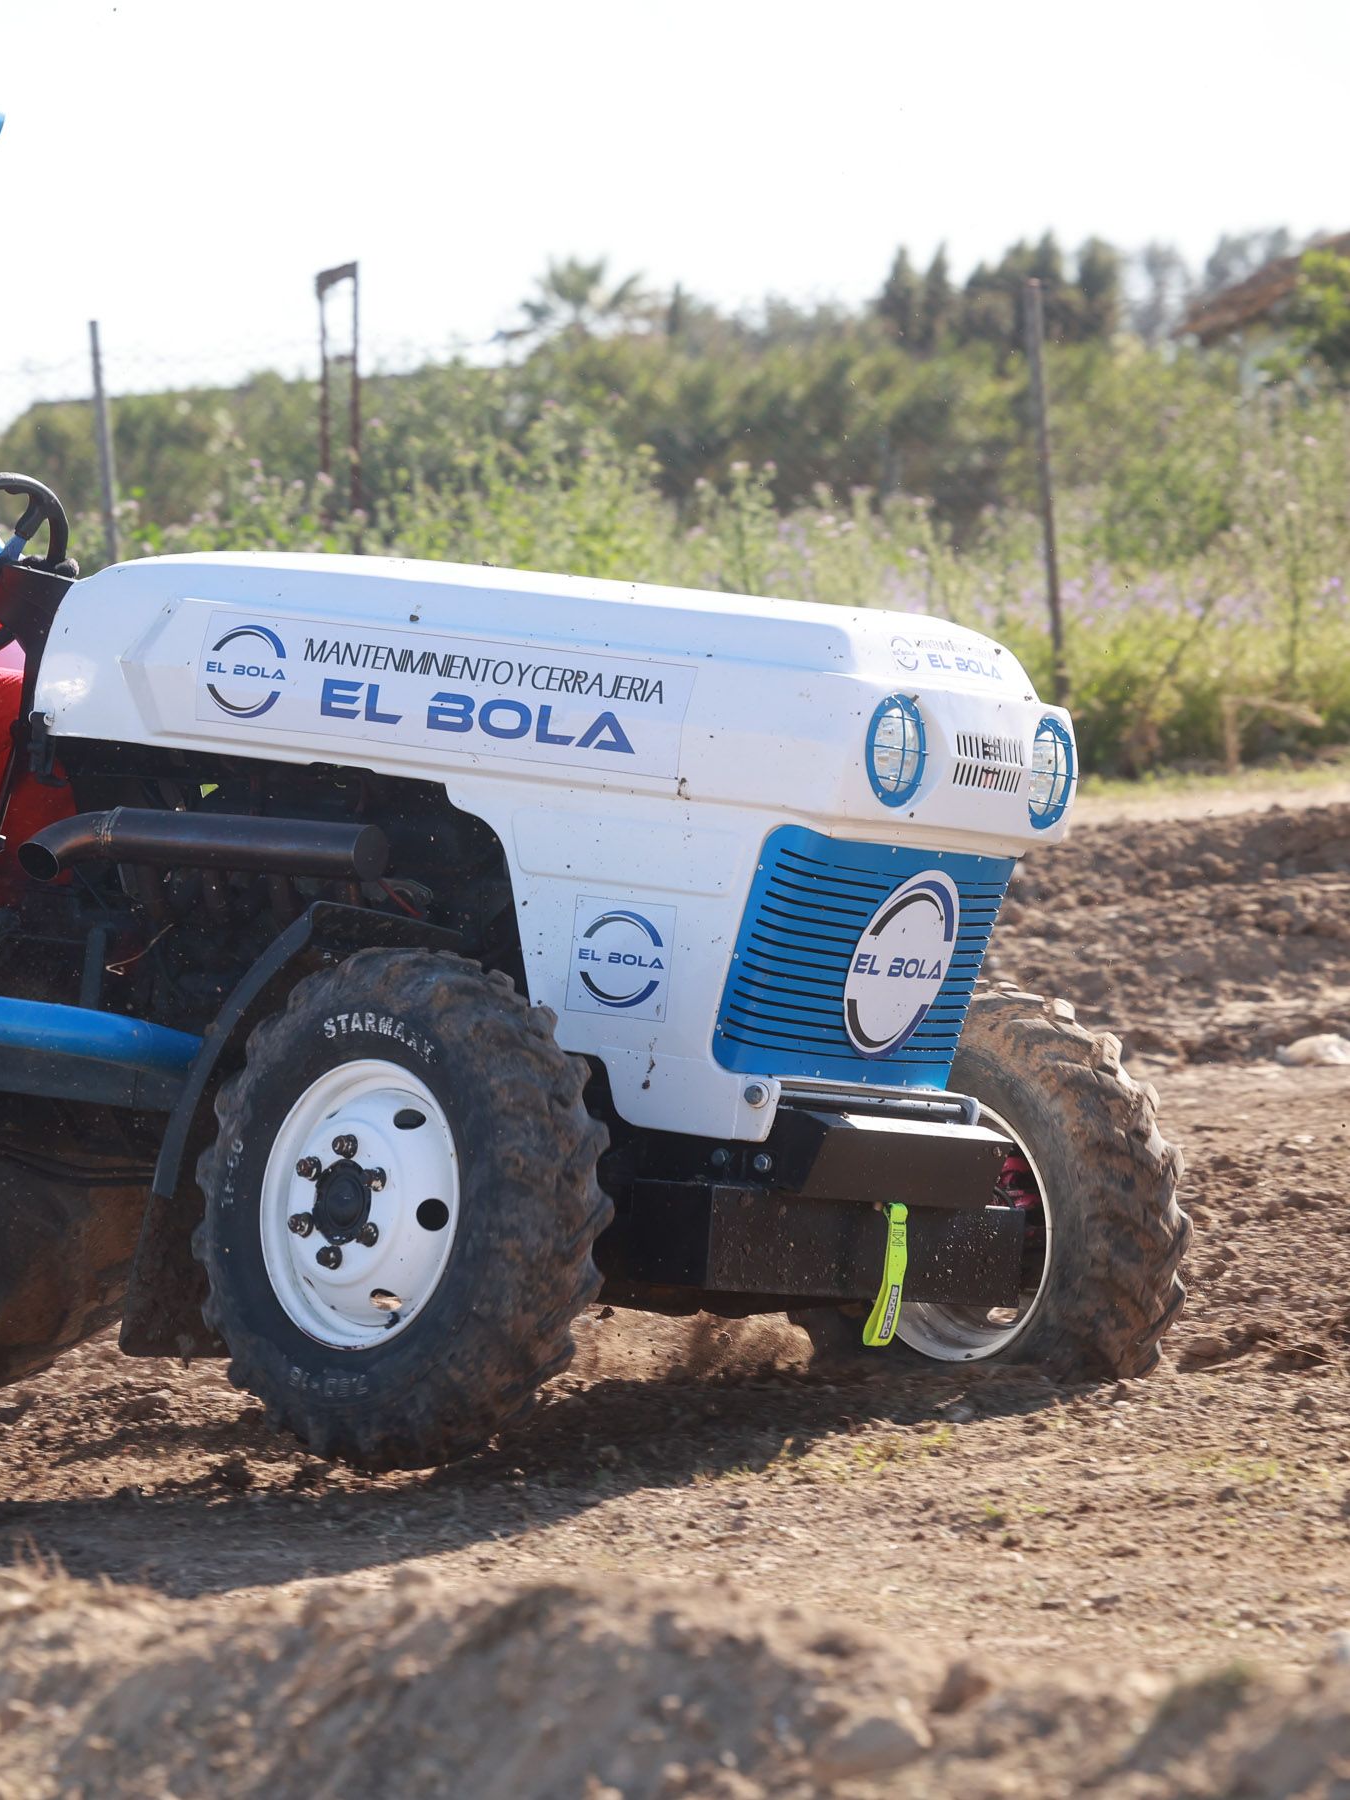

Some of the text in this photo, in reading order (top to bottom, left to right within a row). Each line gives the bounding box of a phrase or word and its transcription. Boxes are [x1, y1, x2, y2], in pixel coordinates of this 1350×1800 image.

[206, 661, 286, 681] EL BOLA
[927, 653, 1003, 681] EL BOLA
[320, 678, 636, 755] EL BOLA
[577, 948, 665, 971] EL BOLA
[852, 953, 942, 980] EL BOLA
